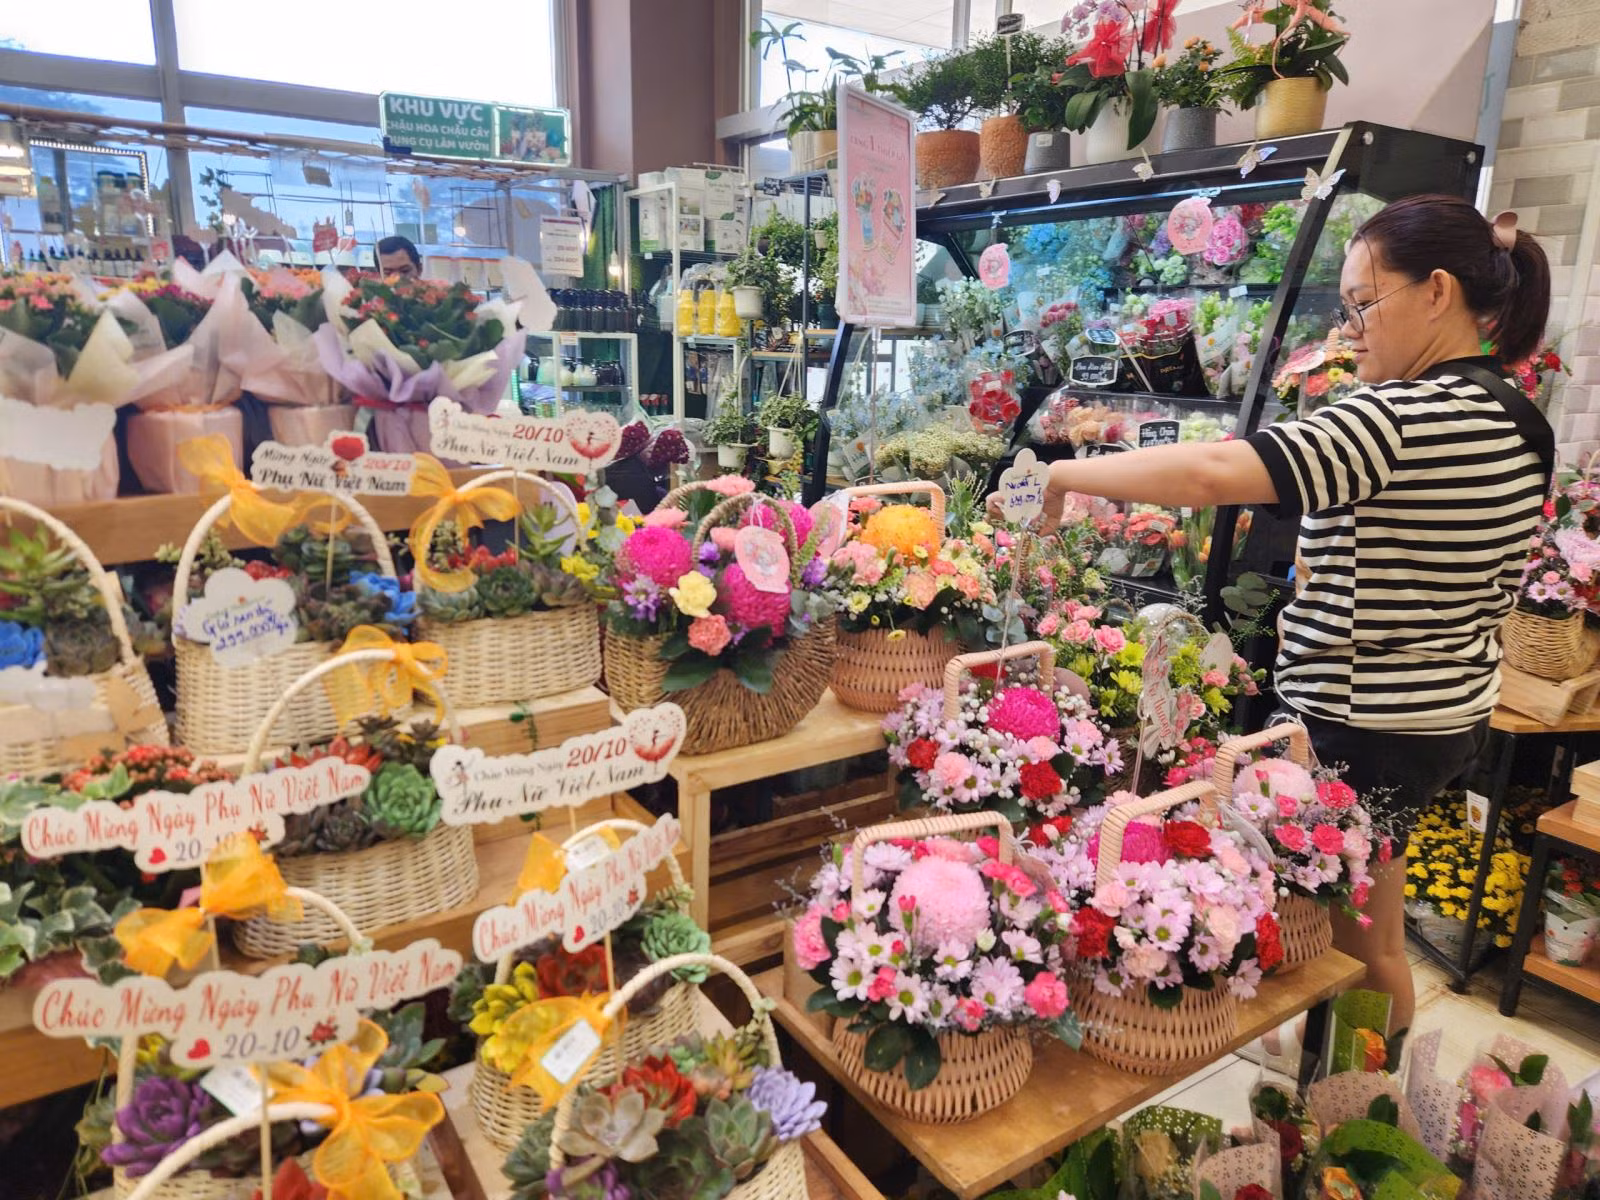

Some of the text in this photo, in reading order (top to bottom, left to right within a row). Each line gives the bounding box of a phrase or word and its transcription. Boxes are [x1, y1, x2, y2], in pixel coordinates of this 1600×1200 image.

[389, 96, 484, 125] KHU VỰC
[512, 423, 564, 444] 20/10
[363, 457, 411, 471] 20/10
[367, 476, 406, 492] Nam
[566, 736, 626, 768] 20/10
[596, 764, 645, 787] Nam
[28, 766, 364, 851] Chúc Mừng Ngày Phụ Nữ Việt Nam
[41, 949, 457, 1032] Chúc Mừng Ngày Phụ Nữ Việt Nam
[220, 1025, 300, 1059] 20-10
